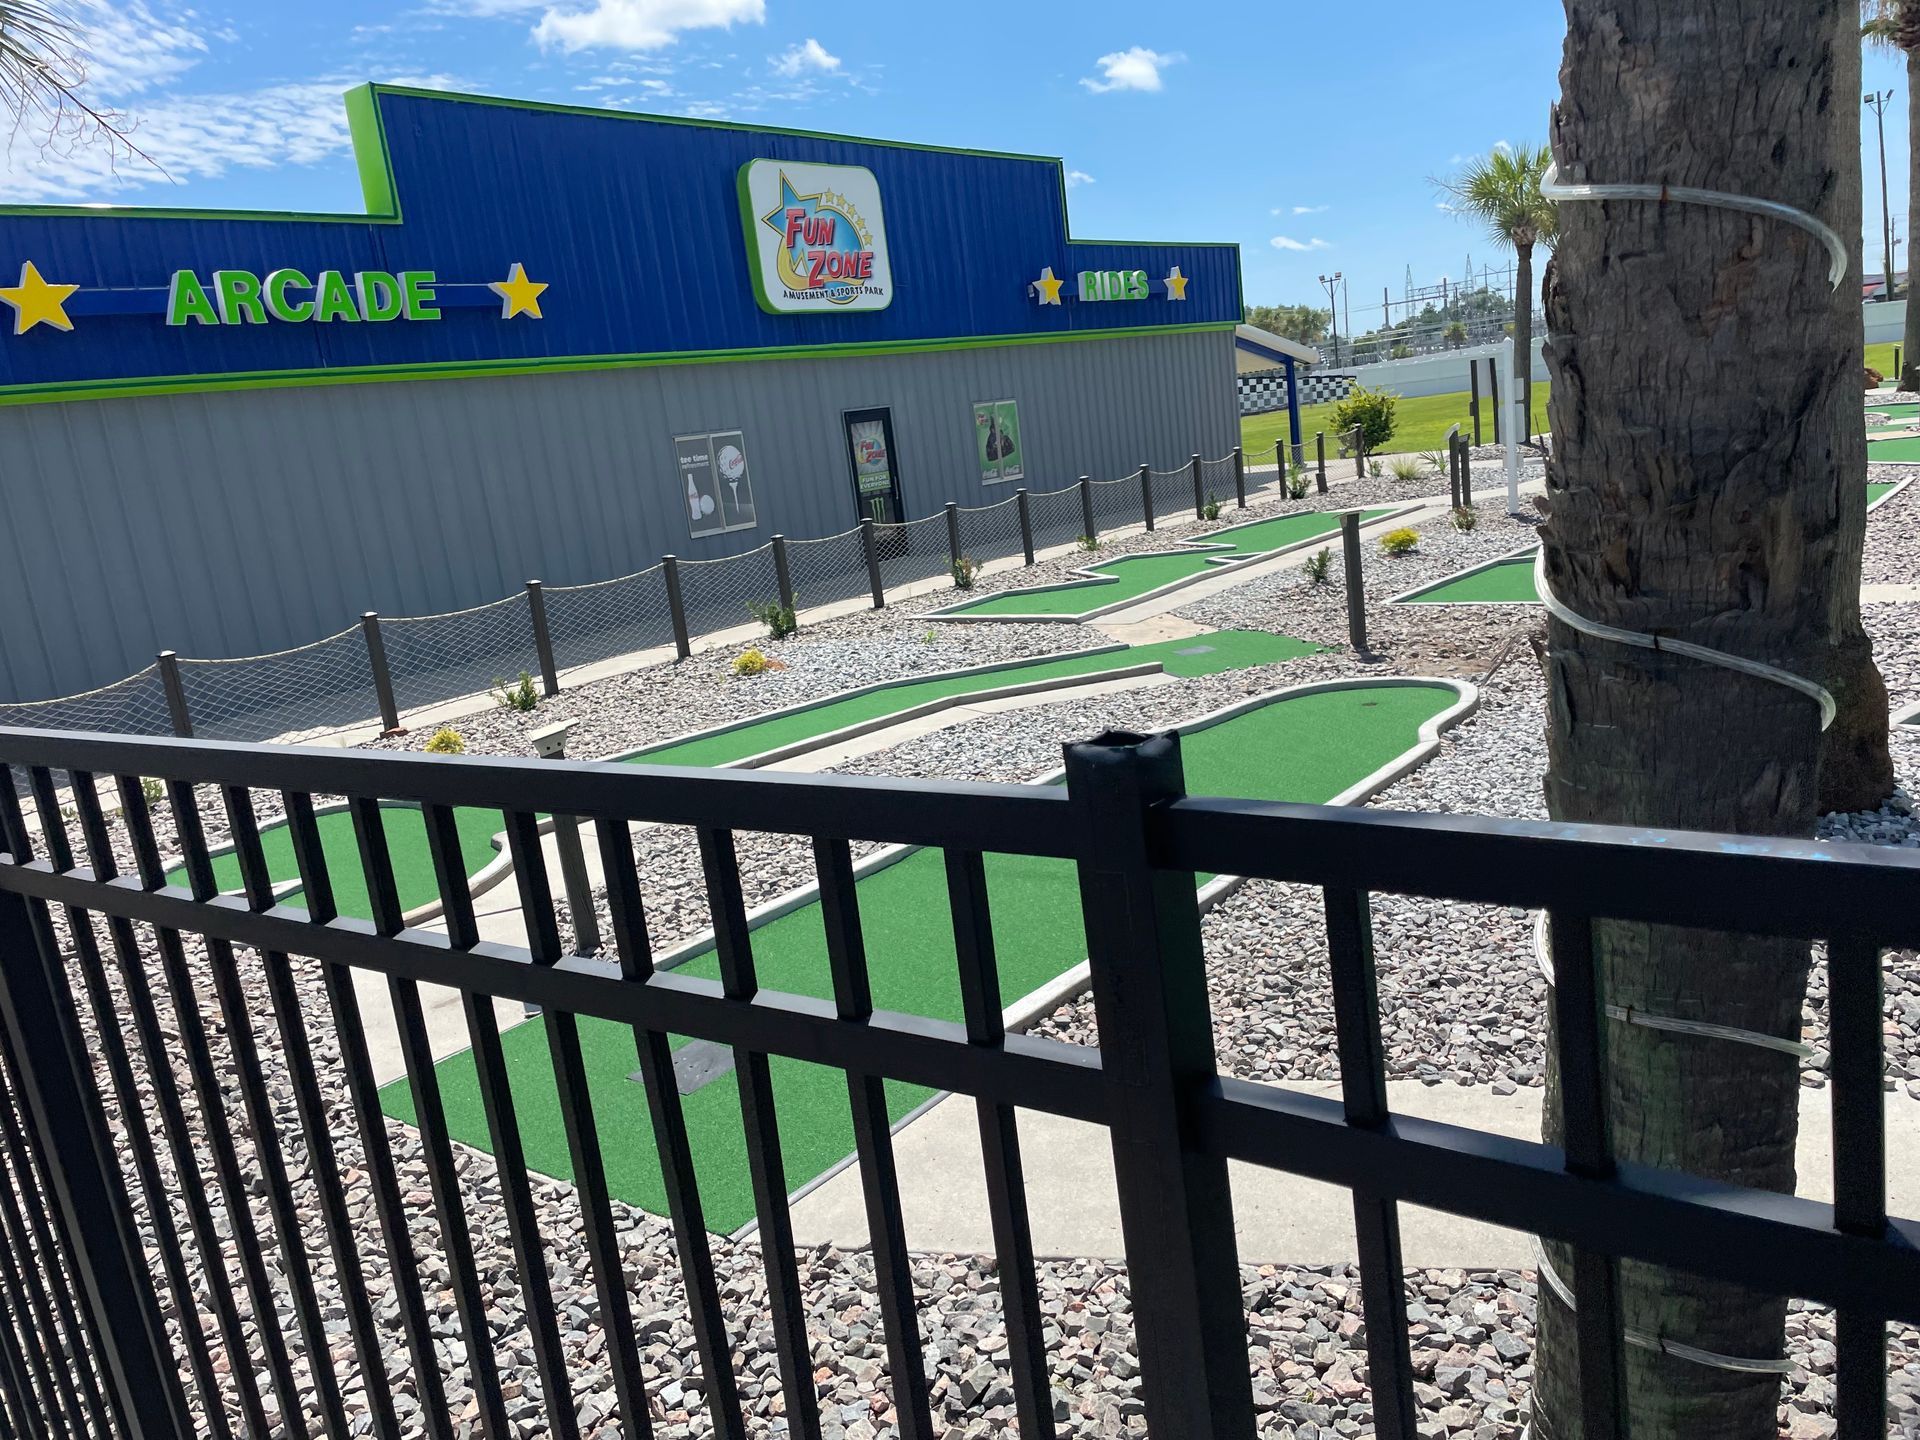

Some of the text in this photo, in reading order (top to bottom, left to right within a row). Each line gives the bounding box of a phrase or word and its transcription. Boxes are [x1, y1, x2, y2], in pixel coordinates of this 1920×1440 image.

[808, 251, 874, 289] ZONE
[1077, 270, 1149, 301] RIDES
[166, 268, 442, 326] ARCADE
[783, 286, 884, 300] AMUSEMENT & SPORTS PARK
